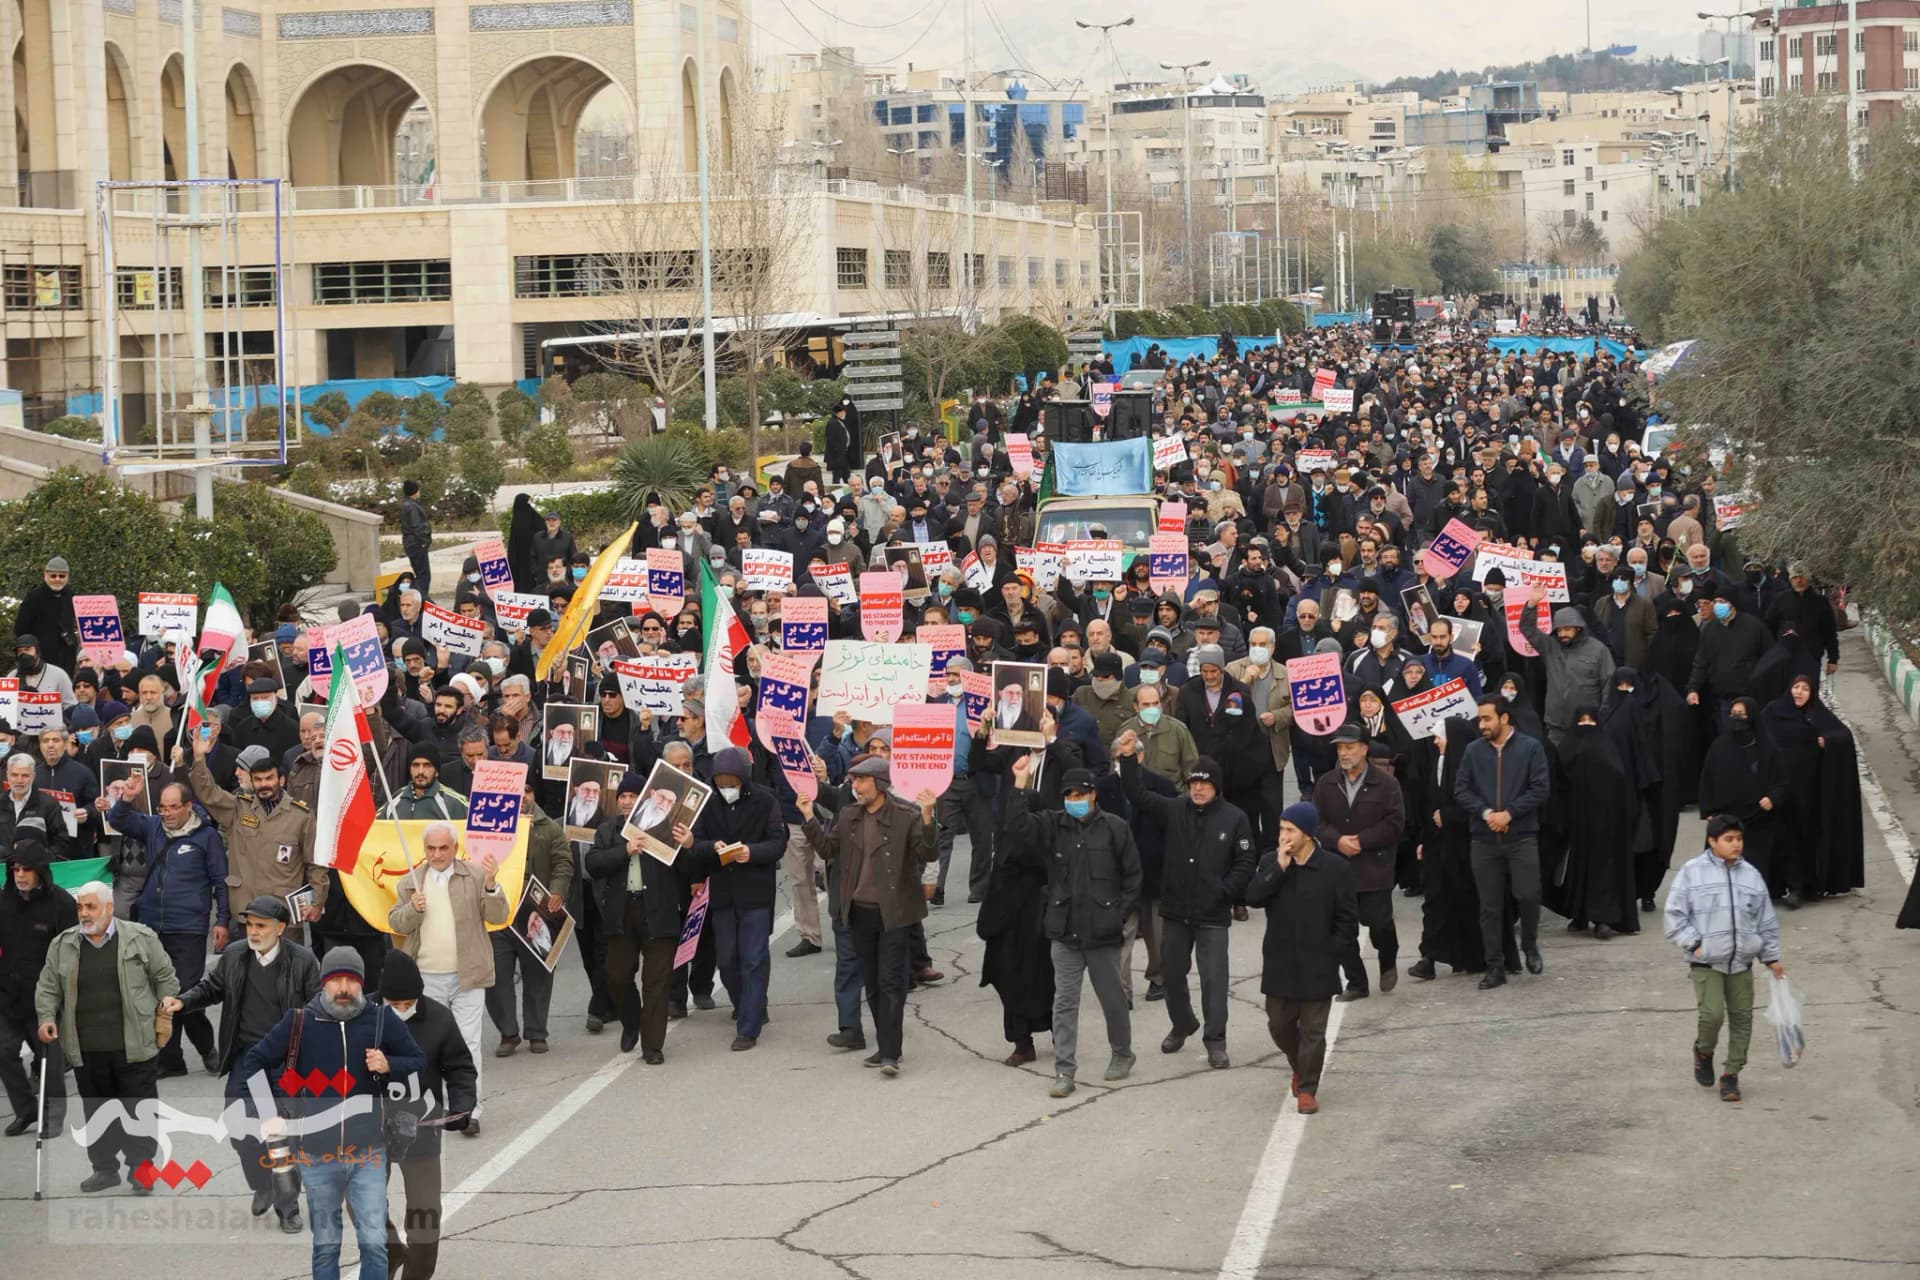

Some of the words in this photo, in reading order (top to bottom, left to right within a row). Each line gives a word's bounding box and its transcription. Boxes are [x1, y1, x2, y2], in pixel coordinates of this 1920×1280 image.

[429, 620, 443, 630] امر
[787, 626, 797, 636] بر
[799, 624, 823, 636] مرگ
[444, 627, 476, 640] مطیع
[866, 670, 898, 682] است
[640, 682, 672, 696] مطیع
[764, 683, 775, 695] بر
[1296, 683, 1307, 696] بر
[1308, 678, 1336, 691] مرگ
[777, 684, 803, 702] مرگ
[887, 684, 922, 706] دشمن
[1430, 696, 1464, 718] مطیع
[474, 796, 486, 810] بر
[488, 794, 516, 812] مرگ
